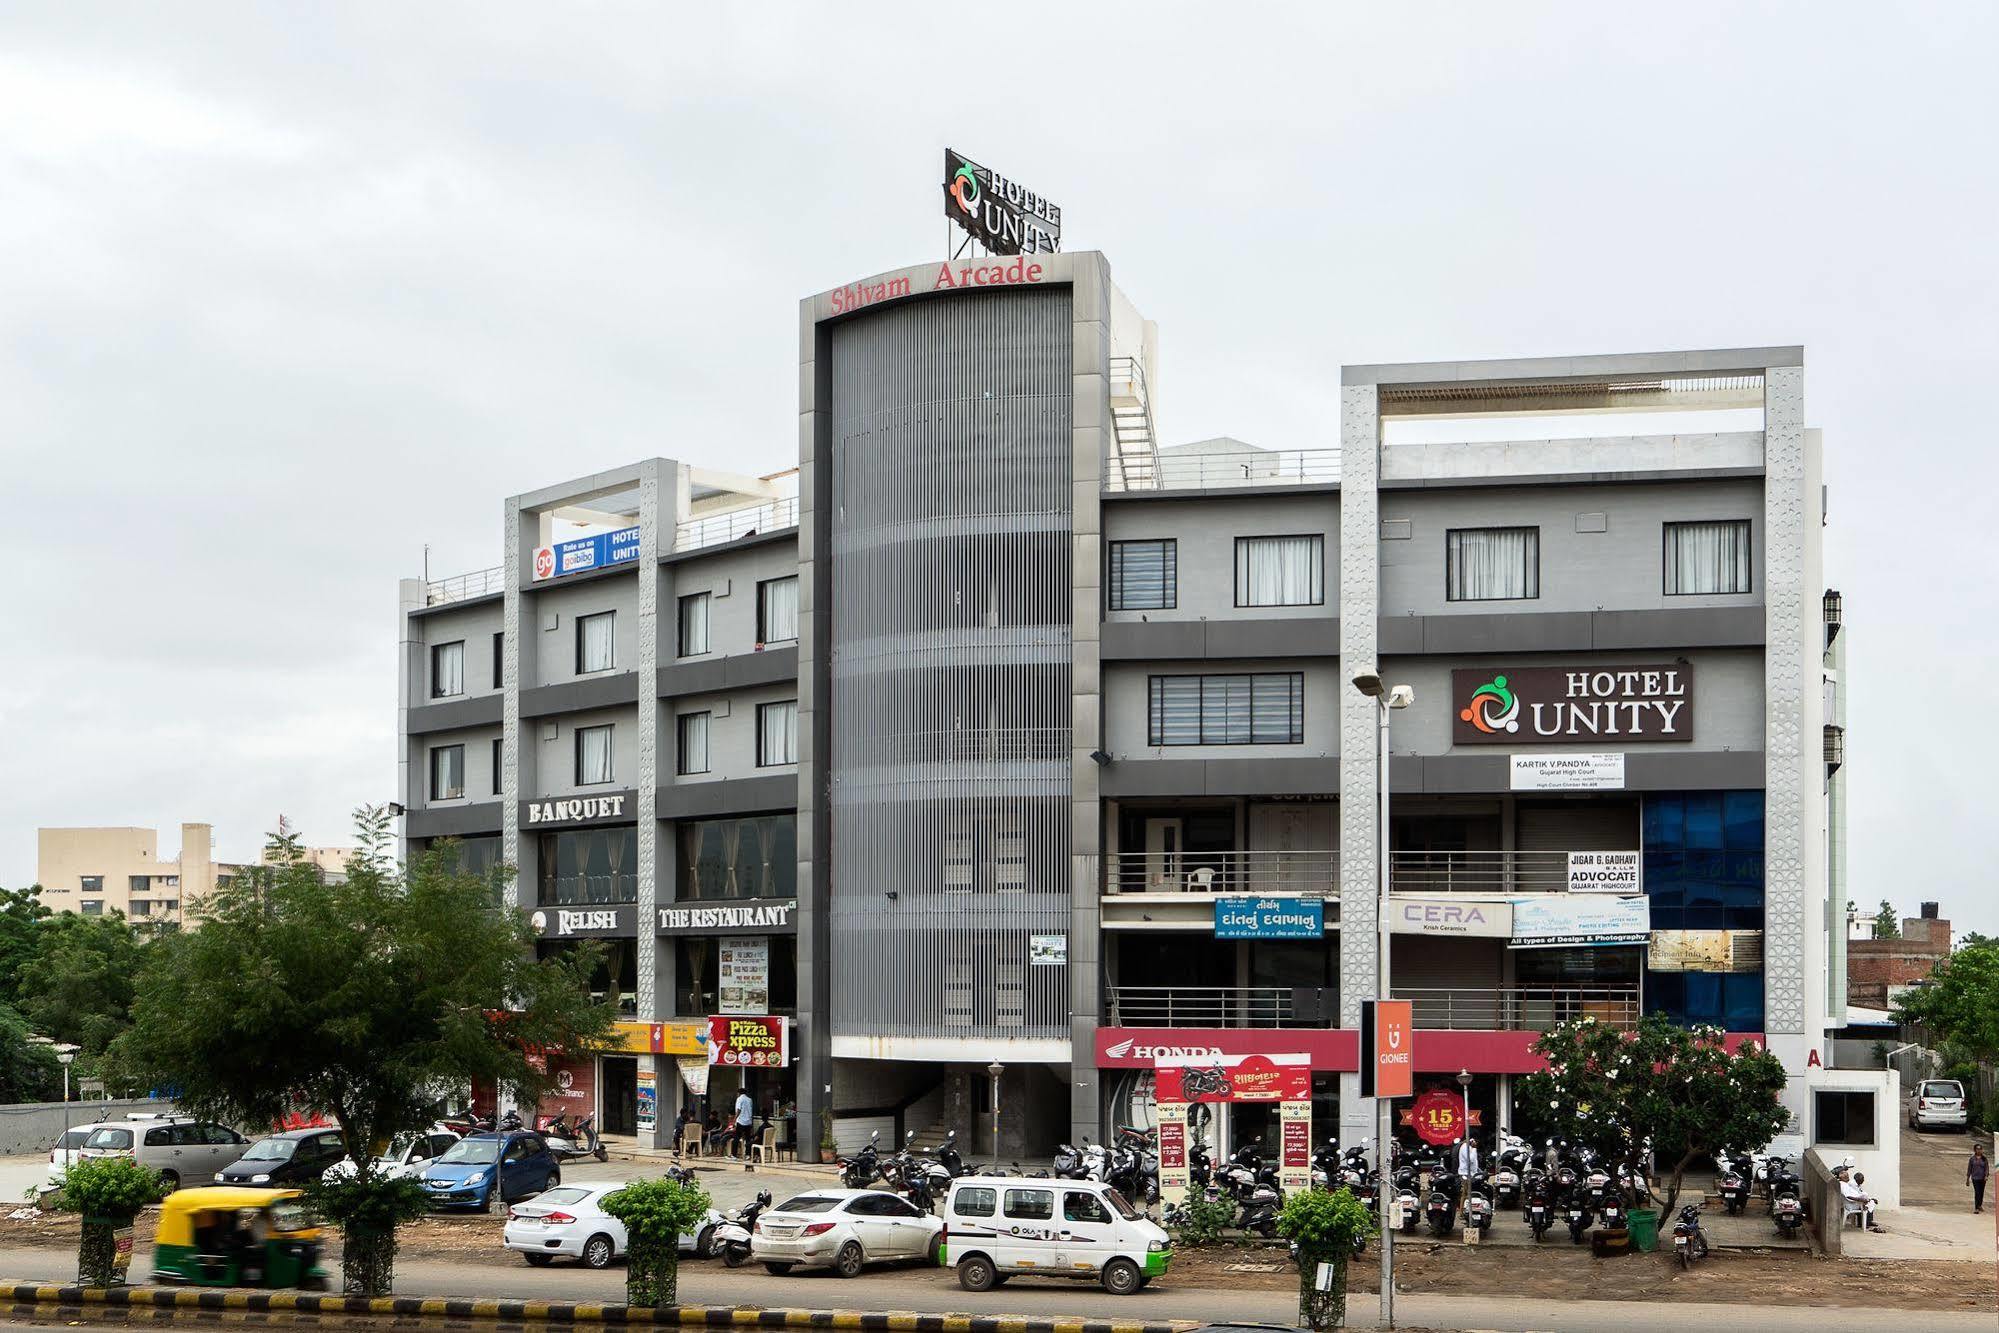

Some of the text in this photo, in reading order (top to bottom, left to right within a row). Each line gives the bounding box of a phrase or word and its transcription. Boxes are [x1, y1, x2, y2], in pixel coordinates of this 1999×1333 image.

[989, 169, 1058, 223] HOTEL
[831, 257, 1043, 316] Shivam Arcade
[612, 529, 640, 545] HOTE
[563, 544, 577, 552] Rate
[537, 555, 553, 571] go
[564, 553, 592, 569] goibibo
[1566, 671, 1685, 698] HOTEL
[1531, 701, 1685, 736] UNITY
[529, 796, 624, 823] BANQUET
[1571, 855, 1593, 865] JIGAR
[1605, 855, 1636, 865] GADHAVI
[1571, 872, 1636, 881] ADVOCATE
[659, 905, 789, 928] THE RESTAURANT
[1404, 905, 1486, 923] CERA
[558, 910, 617, 935] RELISH
[1524, 937, 1545, 945] types
[1557, 936, 1584, 944] Design
[1595, 934, 1646, 942] Photography
[730, 1021, 767, 1035] Pizza
[730, 1036, 776, 1051] xpress
[1133, 1046, 1224, 1058] HONDA
[1380, 1053, 1408, 1064] GIONEE
[1807, 1049, 1821, 1067] A
[1429, 1109, 1453, 1124] 15
